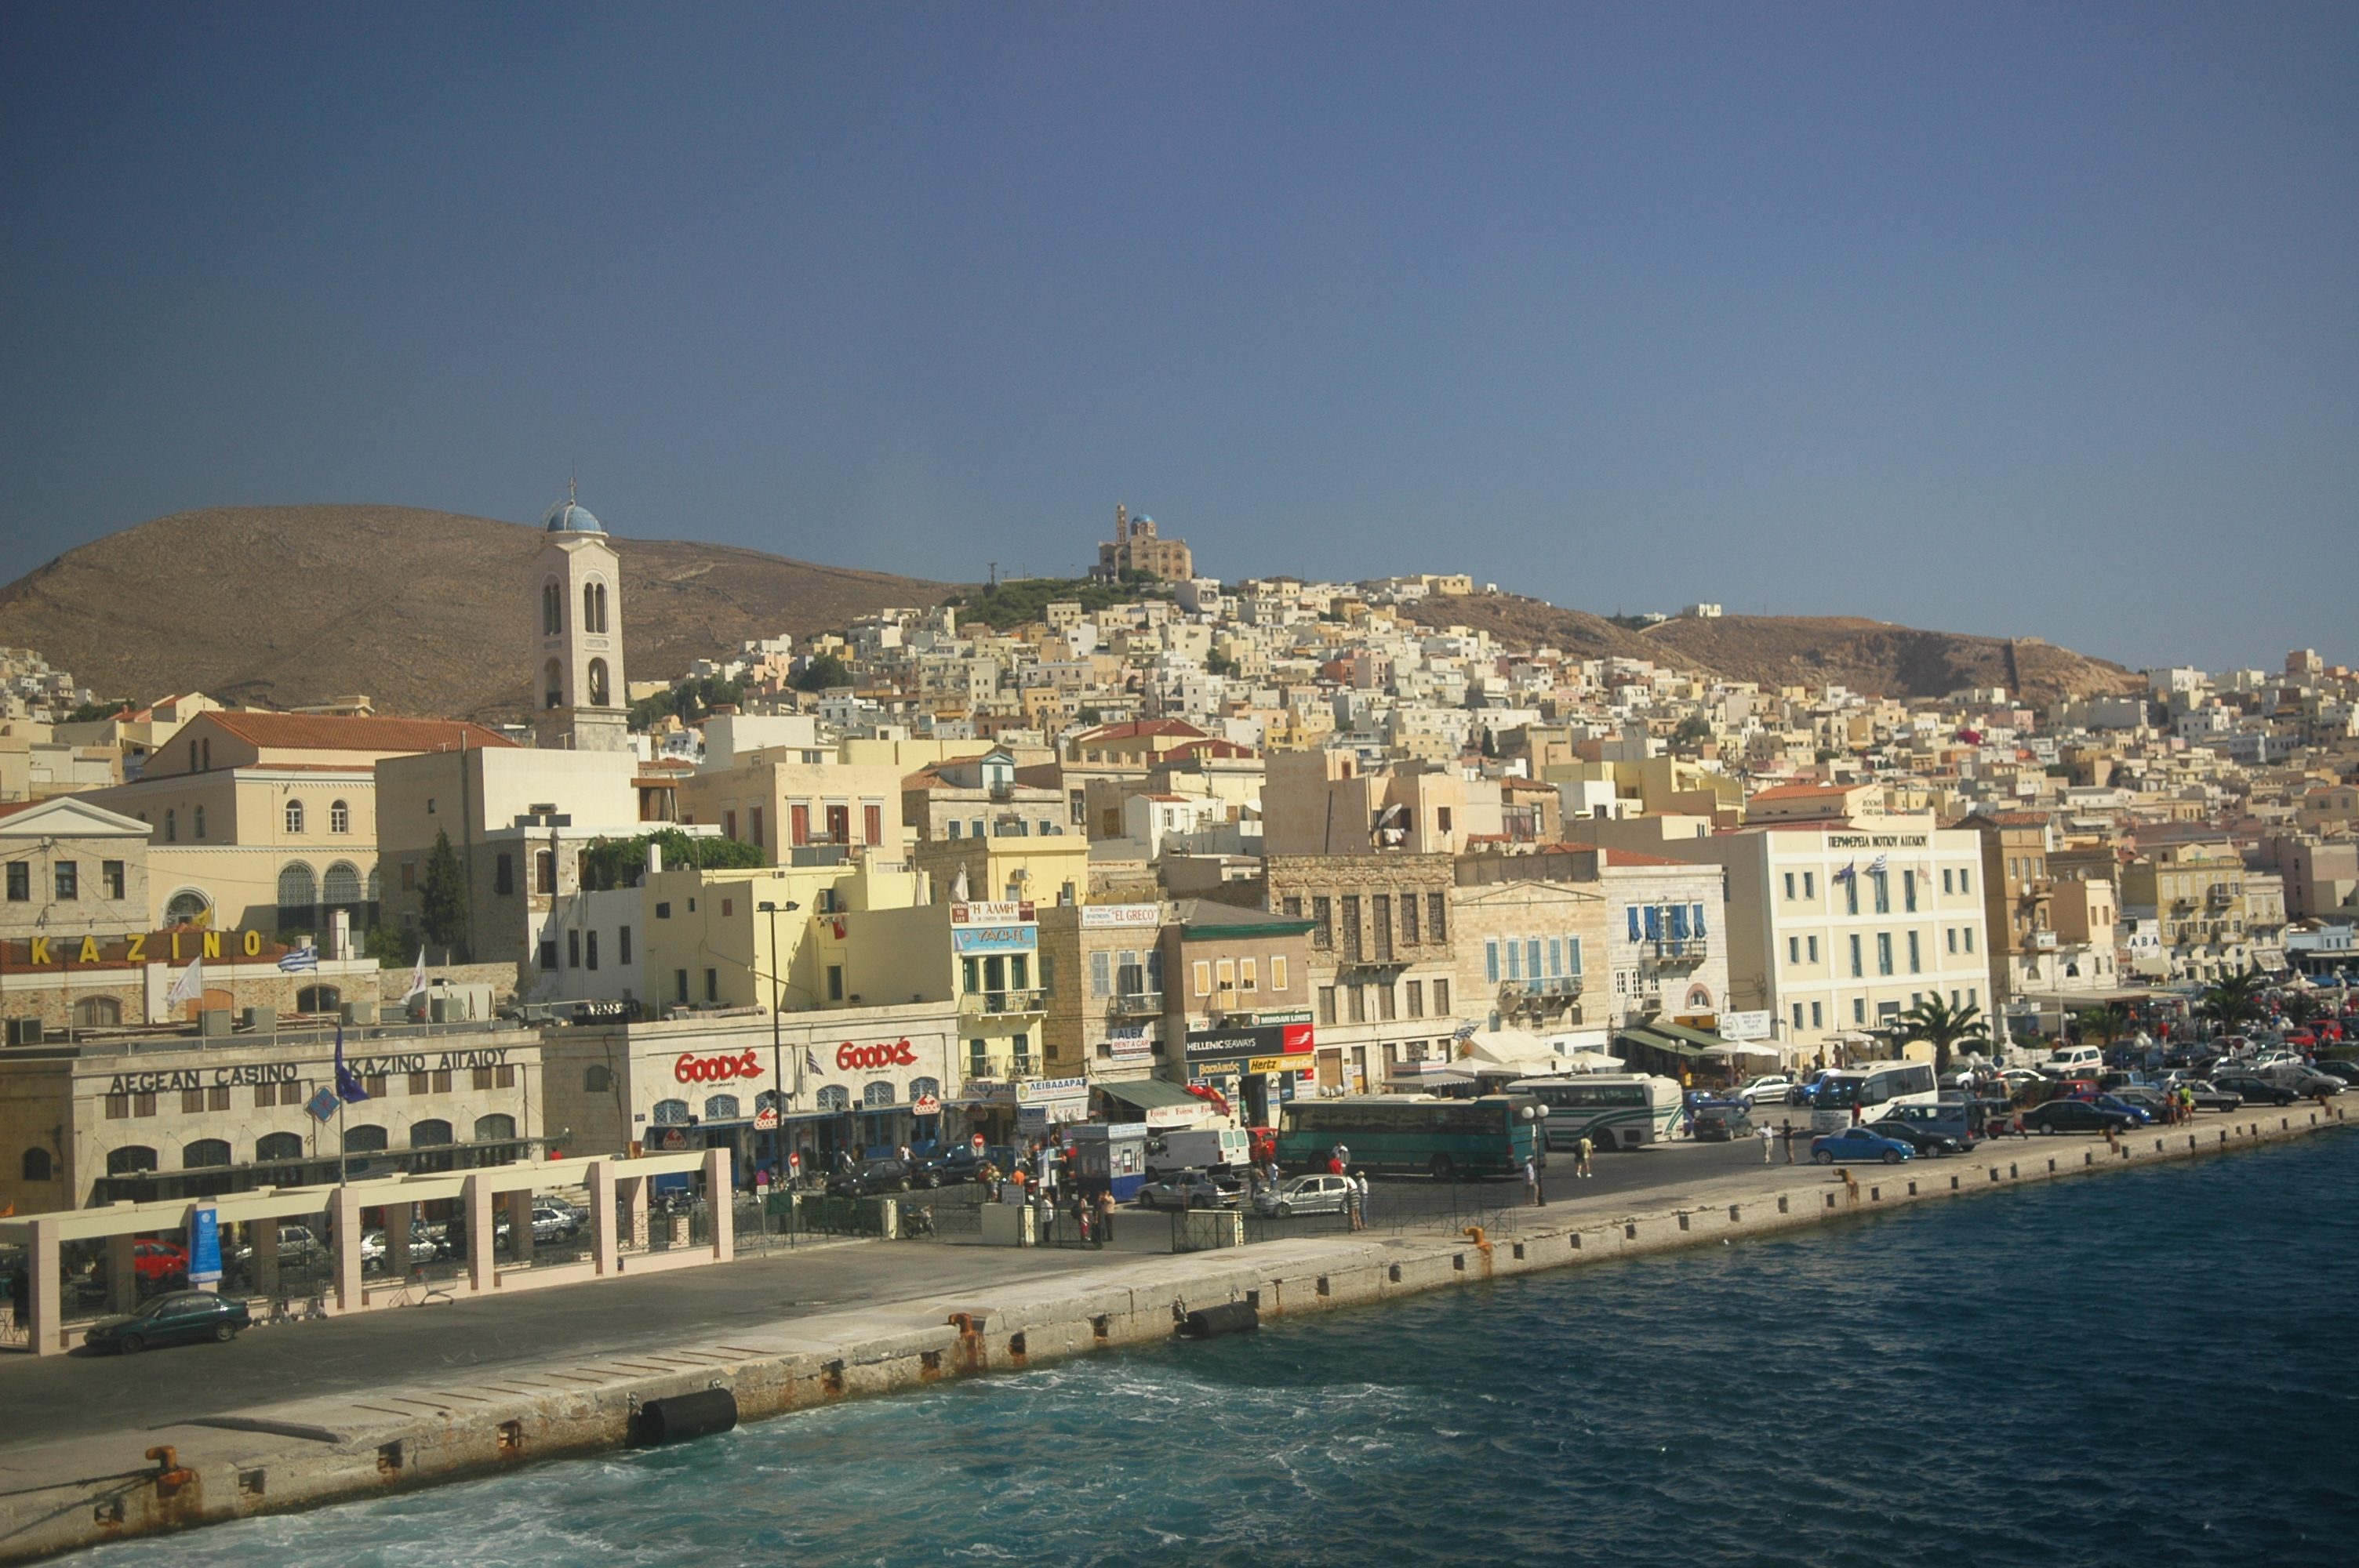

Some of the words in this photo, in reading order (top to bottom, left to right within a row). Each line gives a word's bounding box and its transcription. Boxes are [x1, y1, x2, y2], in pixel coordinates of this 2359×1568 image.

[1828, 836, 1870, 848] ΠΕΡΙΦΕΡΕΙΑ
[1872, 836, 1898, 847] ΝΟΤΙΟΥ
[1900, 835, 1927, 847] ΑΙΓΑΙΟΥ
[974, 928, 1025, 942] YACHT
[1260, 1015, 1290, 1024] MINOAN
[1290, 1014, 1311, 1022] LINES
[1118, 1028, 1144, 1040] ALEX
[1186, 1040, 1224, 1052] HELLENIC
[1224, 1038, 1256, 1049] SEAWAYS
[438, 1048, 508, 1070] ΑΙΓΑΙΟΥ
[836, 1036, 918, 1070] GOODY'S
[674, 1047, 765, 1083] GOODY'S
[1250, 1059, 1278, 1072] Hertz
[109, 1069, 200, 1094] AEGEAN
[214, 1062, 298, 1087] CASINO
